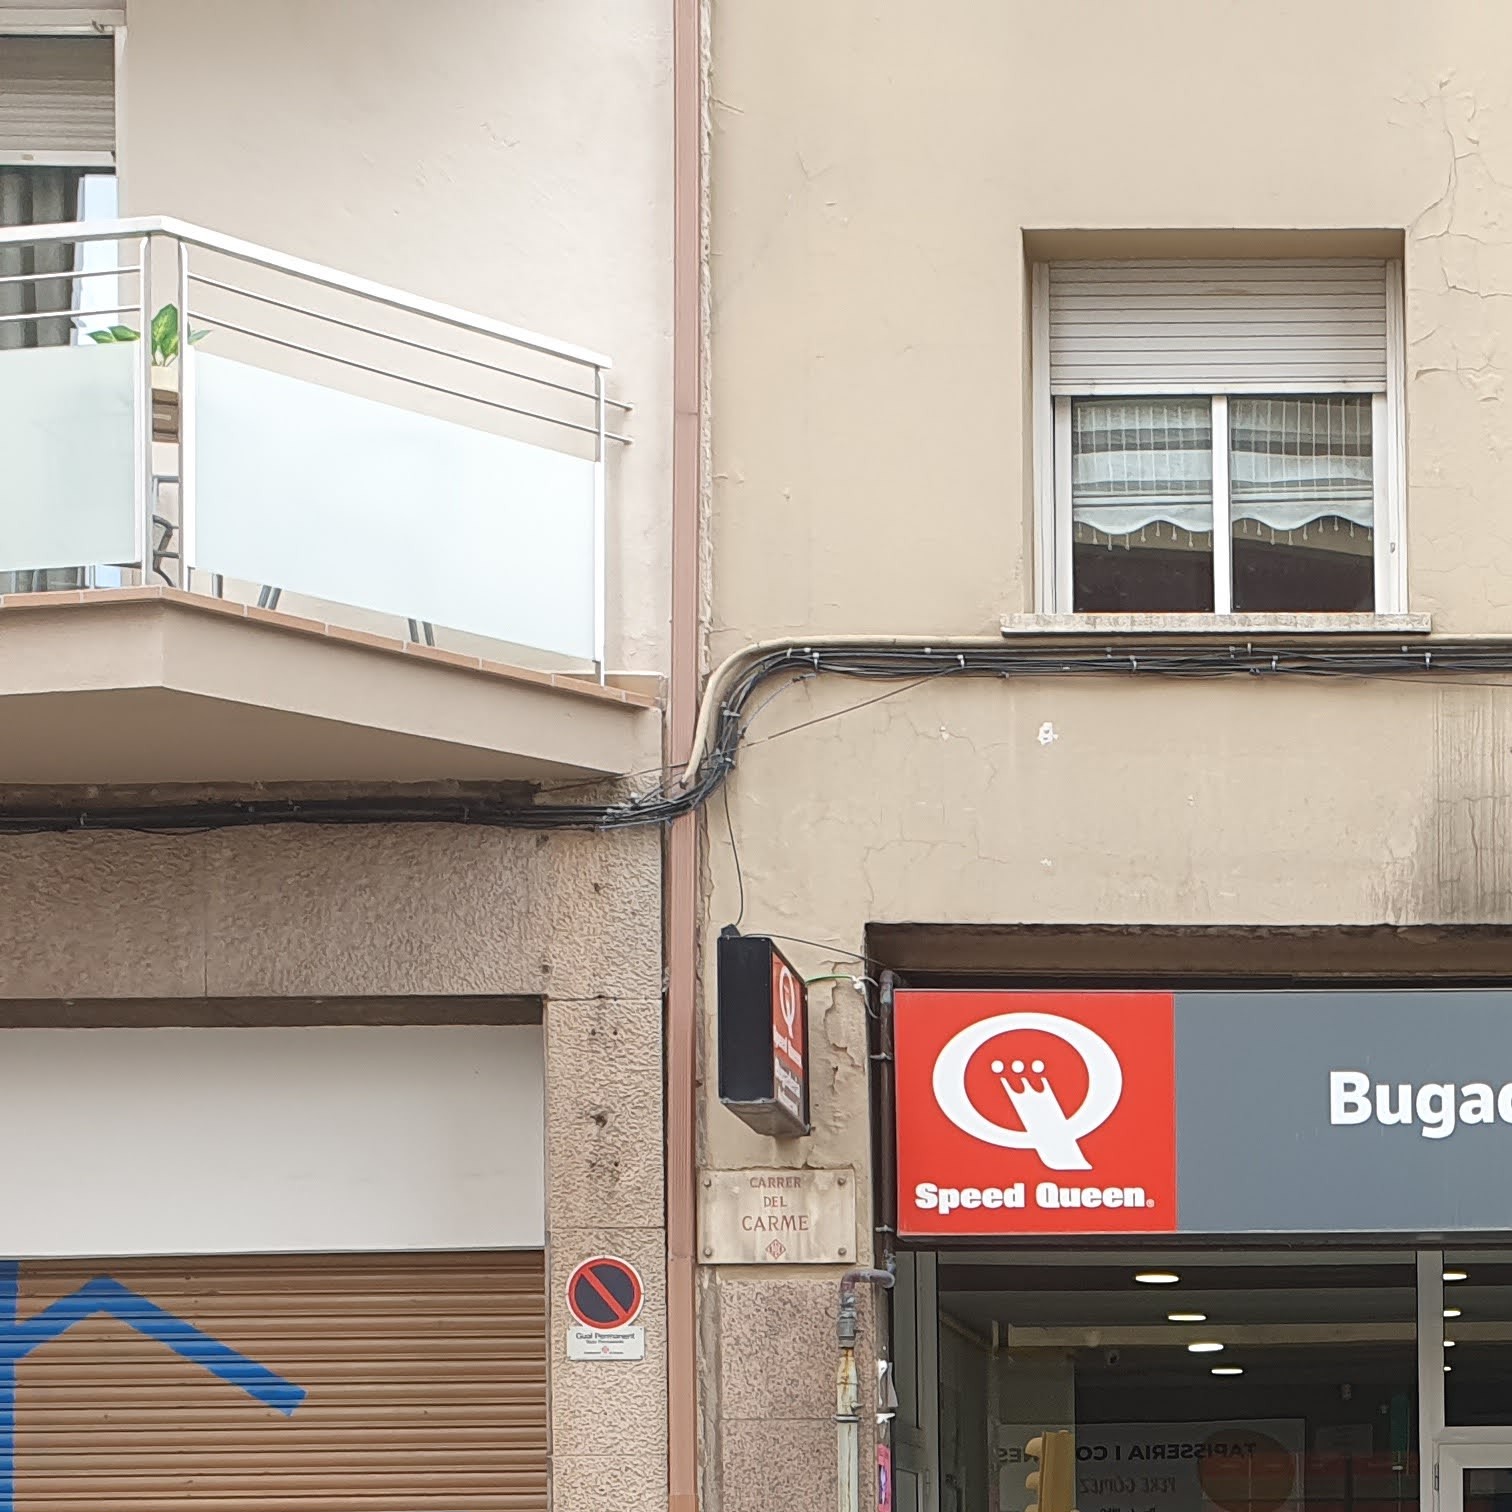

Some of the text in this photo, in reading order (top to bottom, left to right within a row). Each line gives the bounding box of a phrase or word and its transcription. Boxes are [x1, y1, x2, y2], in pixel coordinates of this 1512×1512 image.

[749, 1176, 802, 1189] CARRER
[763, 1196, 788, 1208] DEL
[915, 1182, 1025, 1214] Speed
[741, 1215, 810, 1232] CARME
